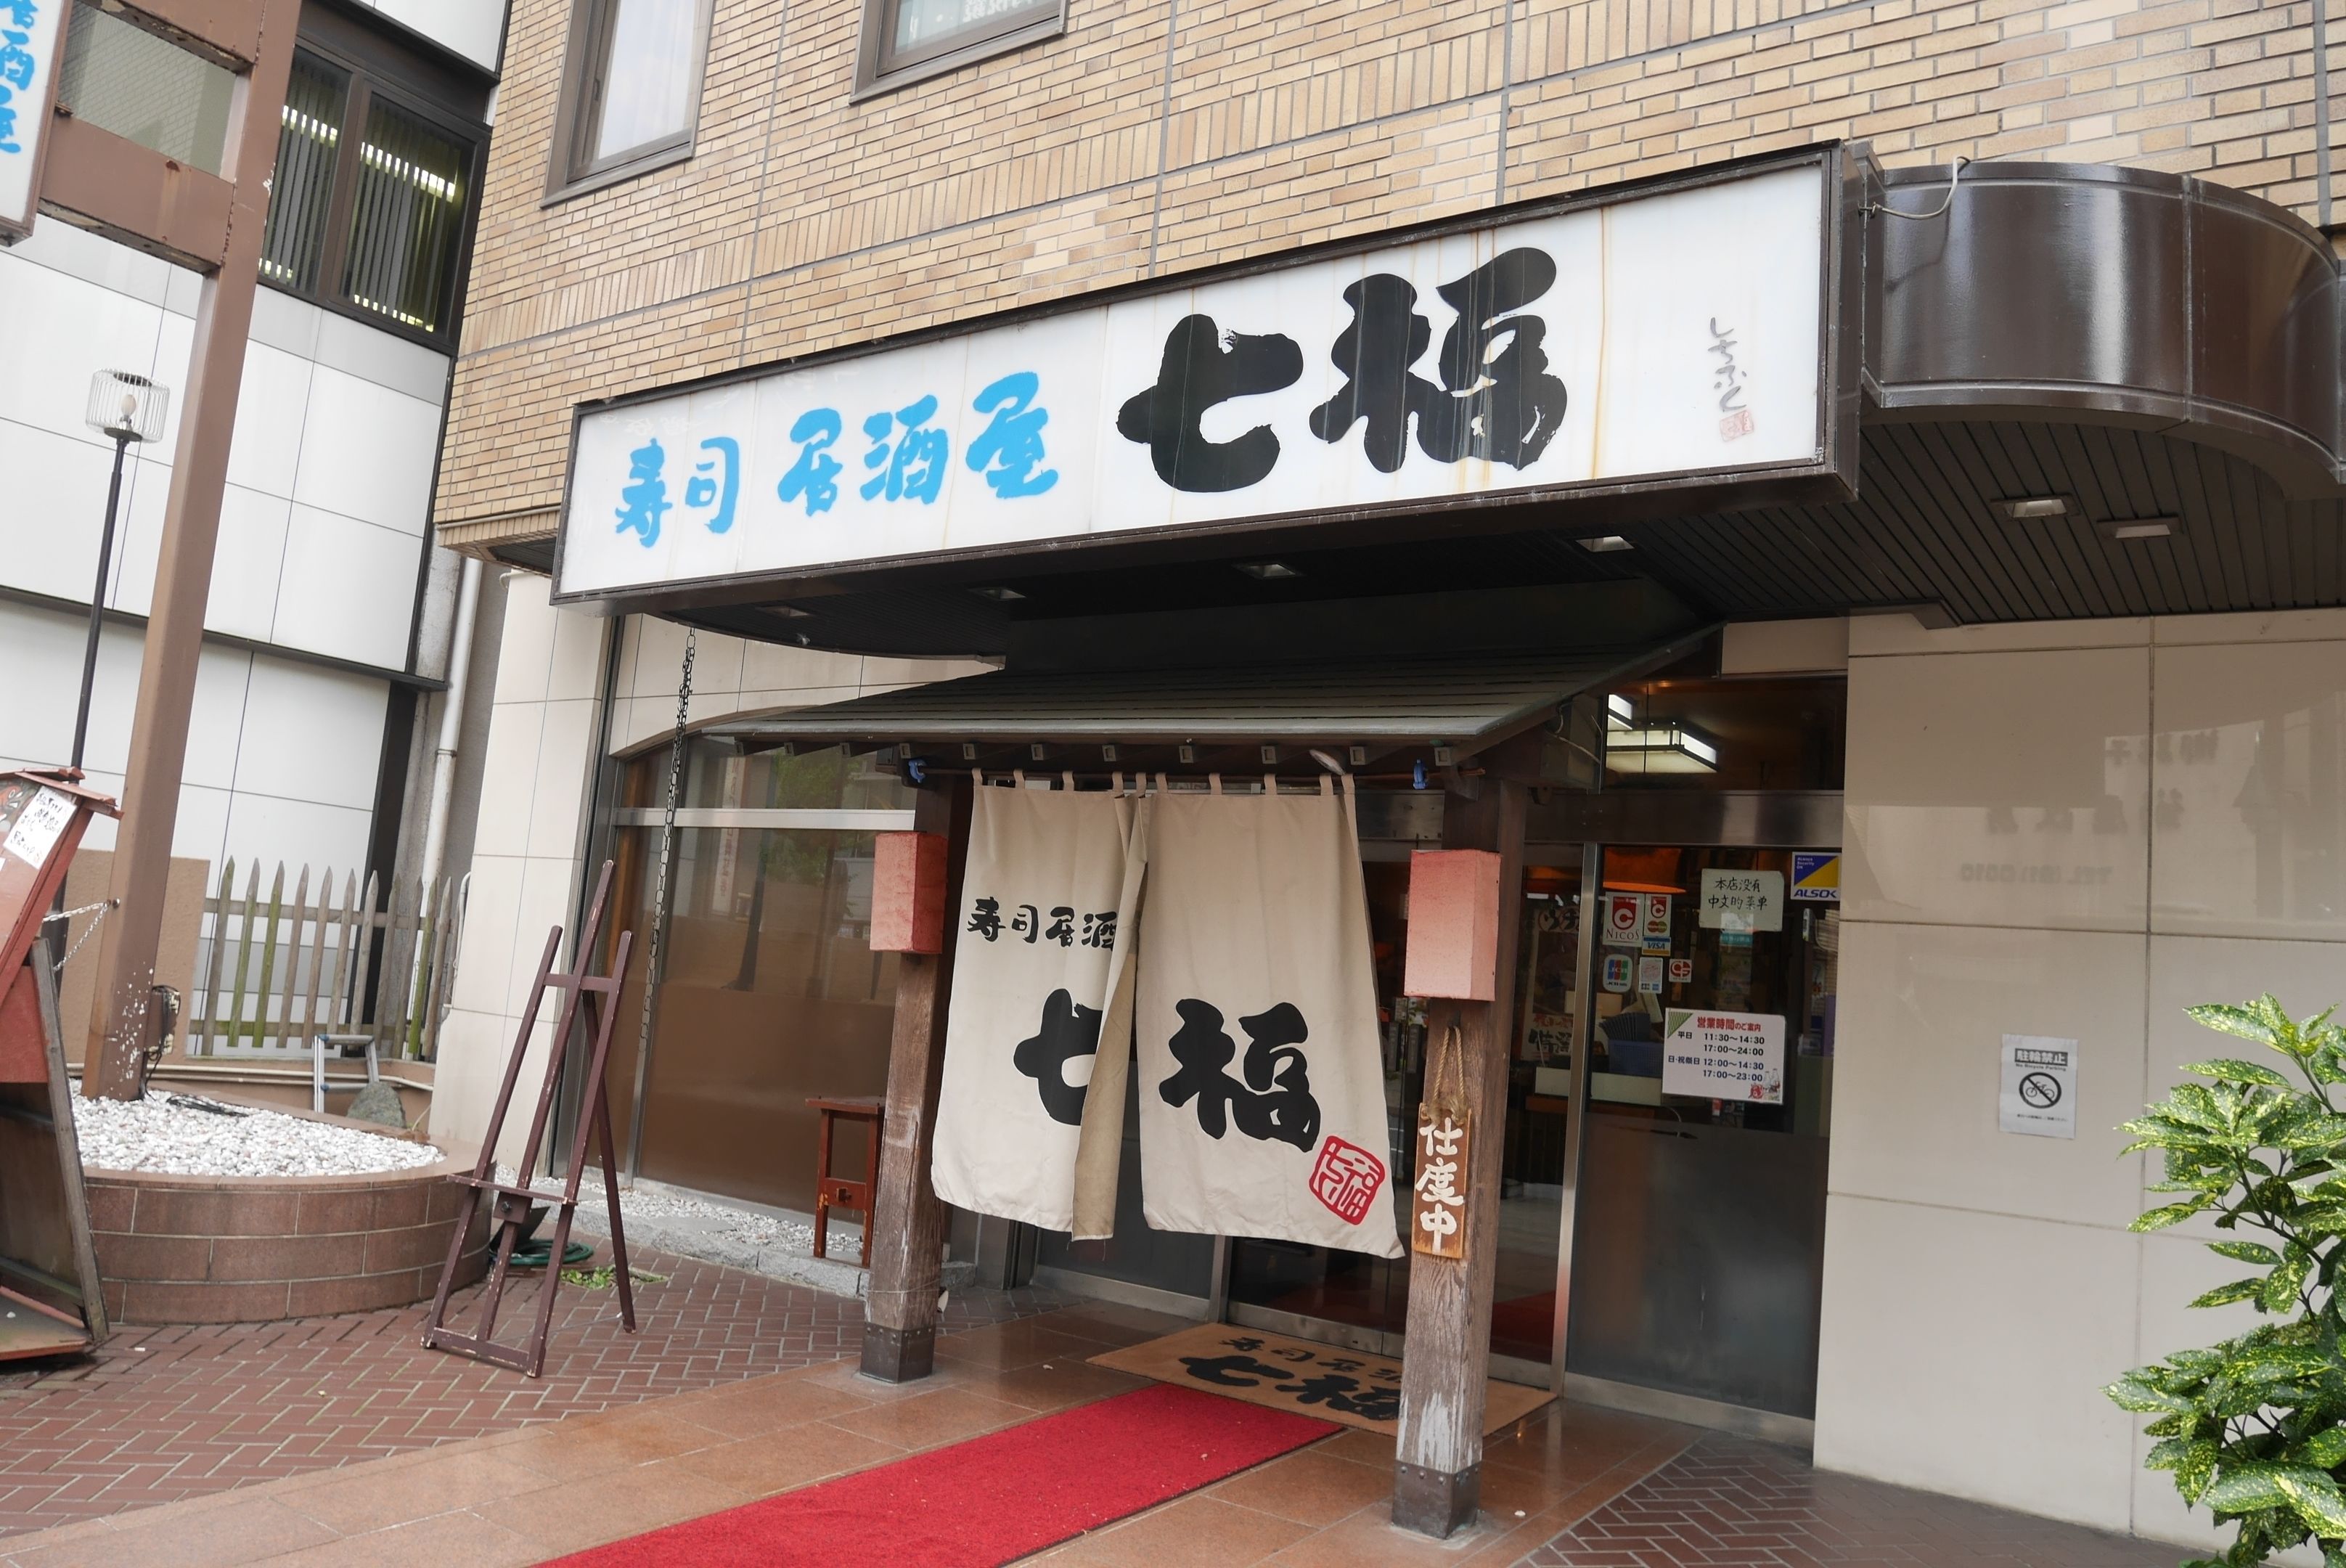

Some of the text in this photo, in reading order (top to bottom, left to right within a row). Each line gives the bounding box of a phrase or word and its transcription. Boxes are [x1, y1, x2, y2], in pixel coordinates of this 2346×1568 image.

[616, 247, 1566, 548] 寿司 居酒屋 七福
[1715, 877, 1760, 892] 本店没有
[1708, 894, 1767, 910] 中文的菜单
[1794, 889, 1836, 899] ALSOK
[1697, 1016, 1761, 1032] 営業時間のご案内
[2016, 1050, 2066, 1064] 駐輪禁止
[1415, 1117, 1464, 1254] 仕度中
